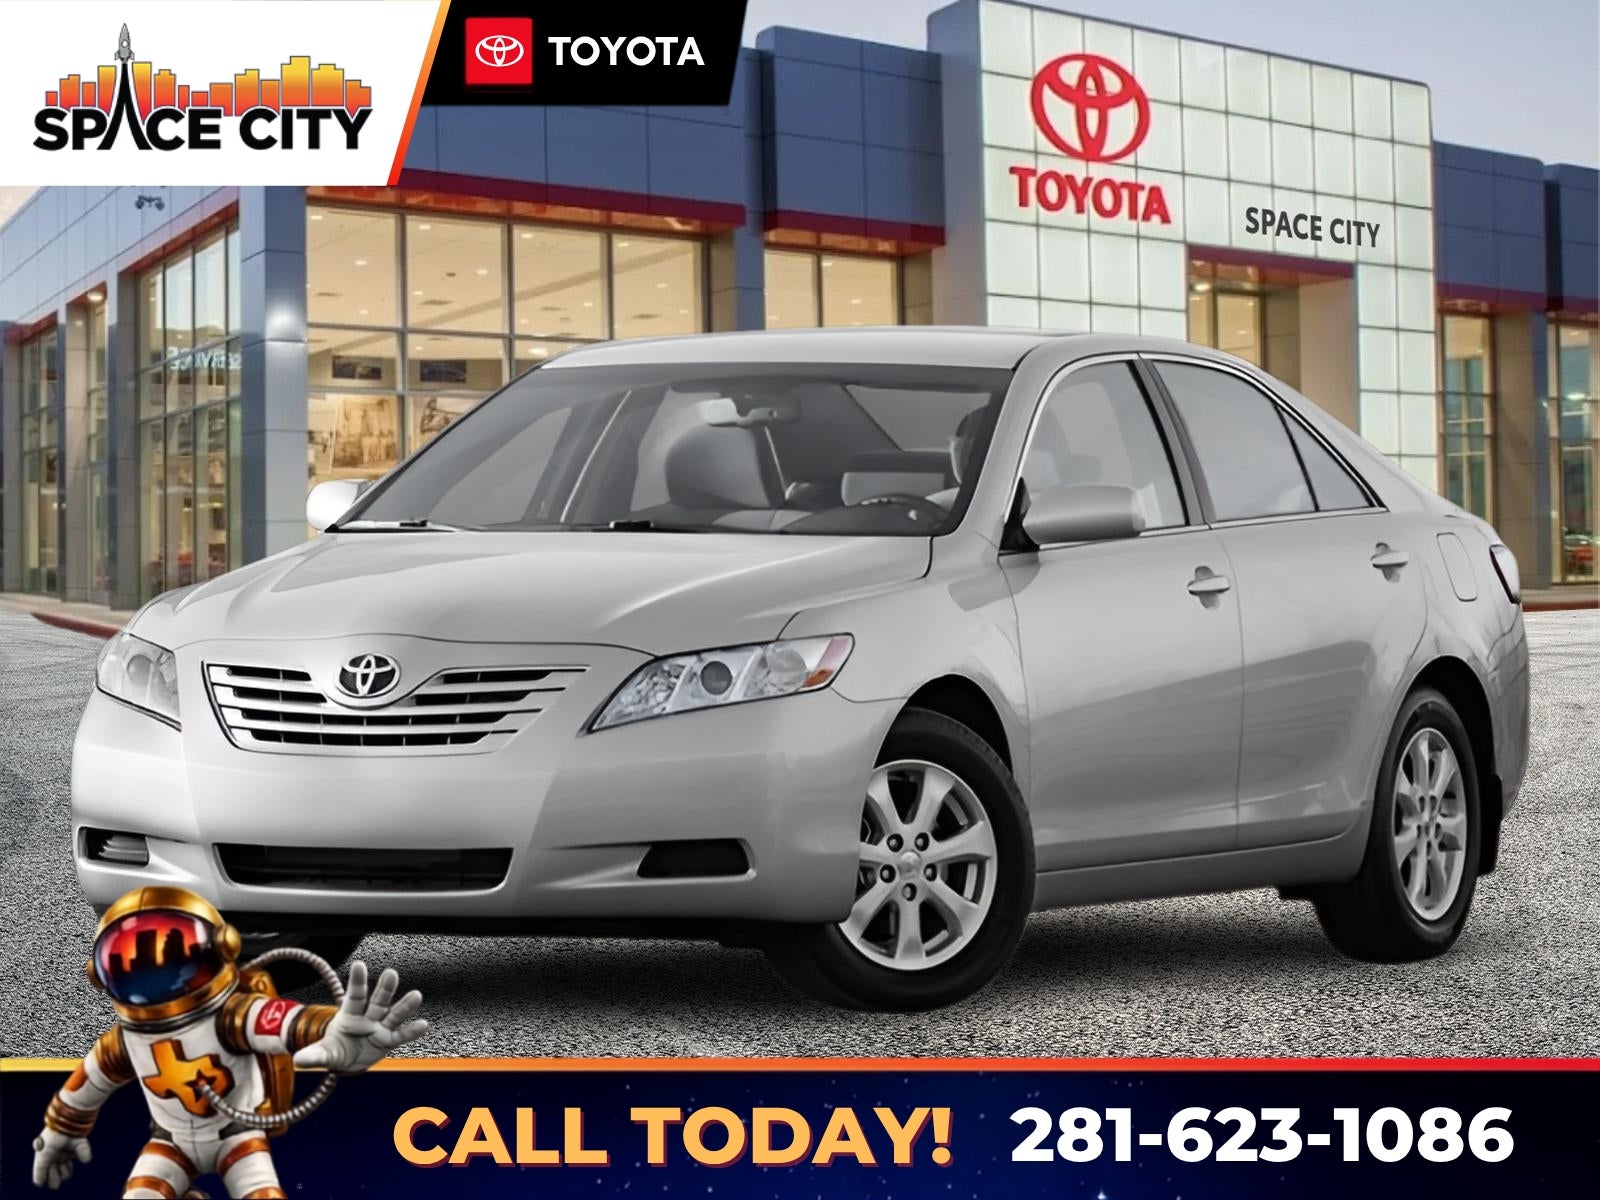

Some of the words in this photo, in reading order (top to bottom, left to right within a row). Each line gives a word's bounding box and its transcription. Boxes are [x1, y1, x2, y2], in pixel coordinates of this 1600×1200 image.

[1008, 166, 1172, 224] TOYOTA
[1245, 206, 1323, 242] SPACE
[1329, 217, 1381, 248] CITY
